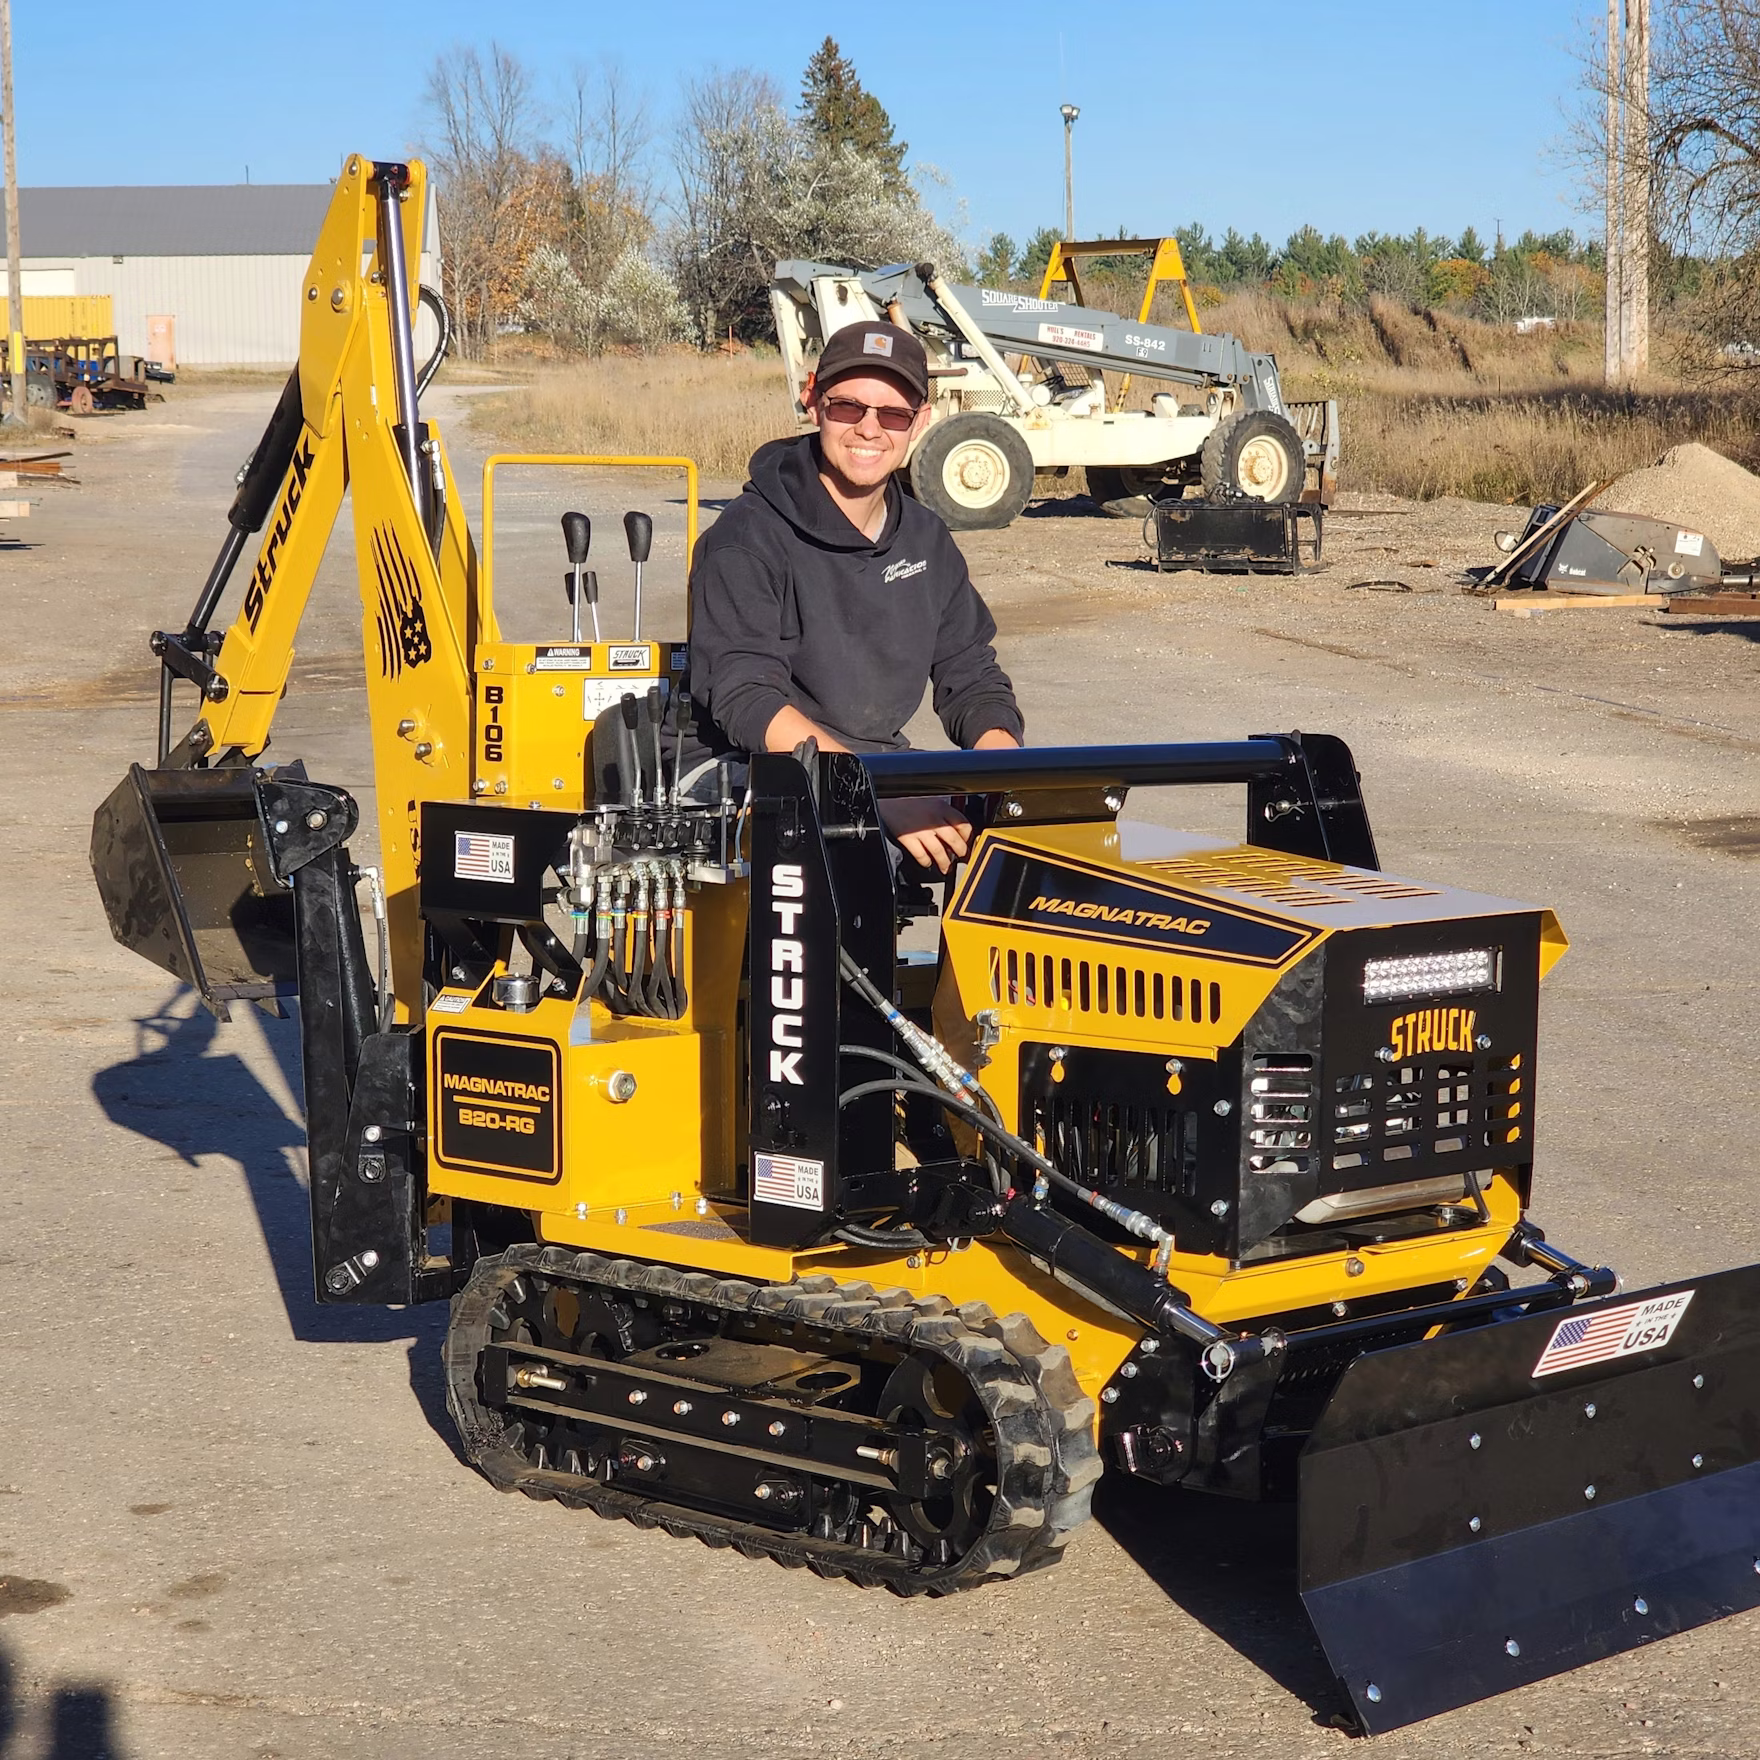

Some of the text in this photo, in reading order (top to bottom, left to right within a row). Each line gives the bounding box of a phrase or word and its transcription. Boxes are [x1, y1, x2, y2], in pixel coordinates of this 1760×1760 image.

[982, 289, 1058, 313] SQUARE SHOOTER
[1074, 330, 1096, 341] RENTALS
[553, 648, 580, 657] WARNING
[613, 649, 647, 663] STRUCK
[485, 686, 504, 762] B106
[492, 841, 510, 850] MADE
[491, 860, 511, 874] USA
[1028, 896, 1212, 935] MAGNATRAC
[770, 864, 804, 1085] STRUCK
[1391, 1008, 1476, 1062] STRUCK
[443, 1073, 550, 1102] MAGNATRAC
[459, 1108, 535, 1134] B20-RG
[797, 1165, 819, 1176] MADE
[796, 1185, 819, 1201] USA
[1641, 1297, 1686, 1316] MADE
[1654, 1313, 1669, 1322] THE
[1623, 1324, 1670, 1349] USA
